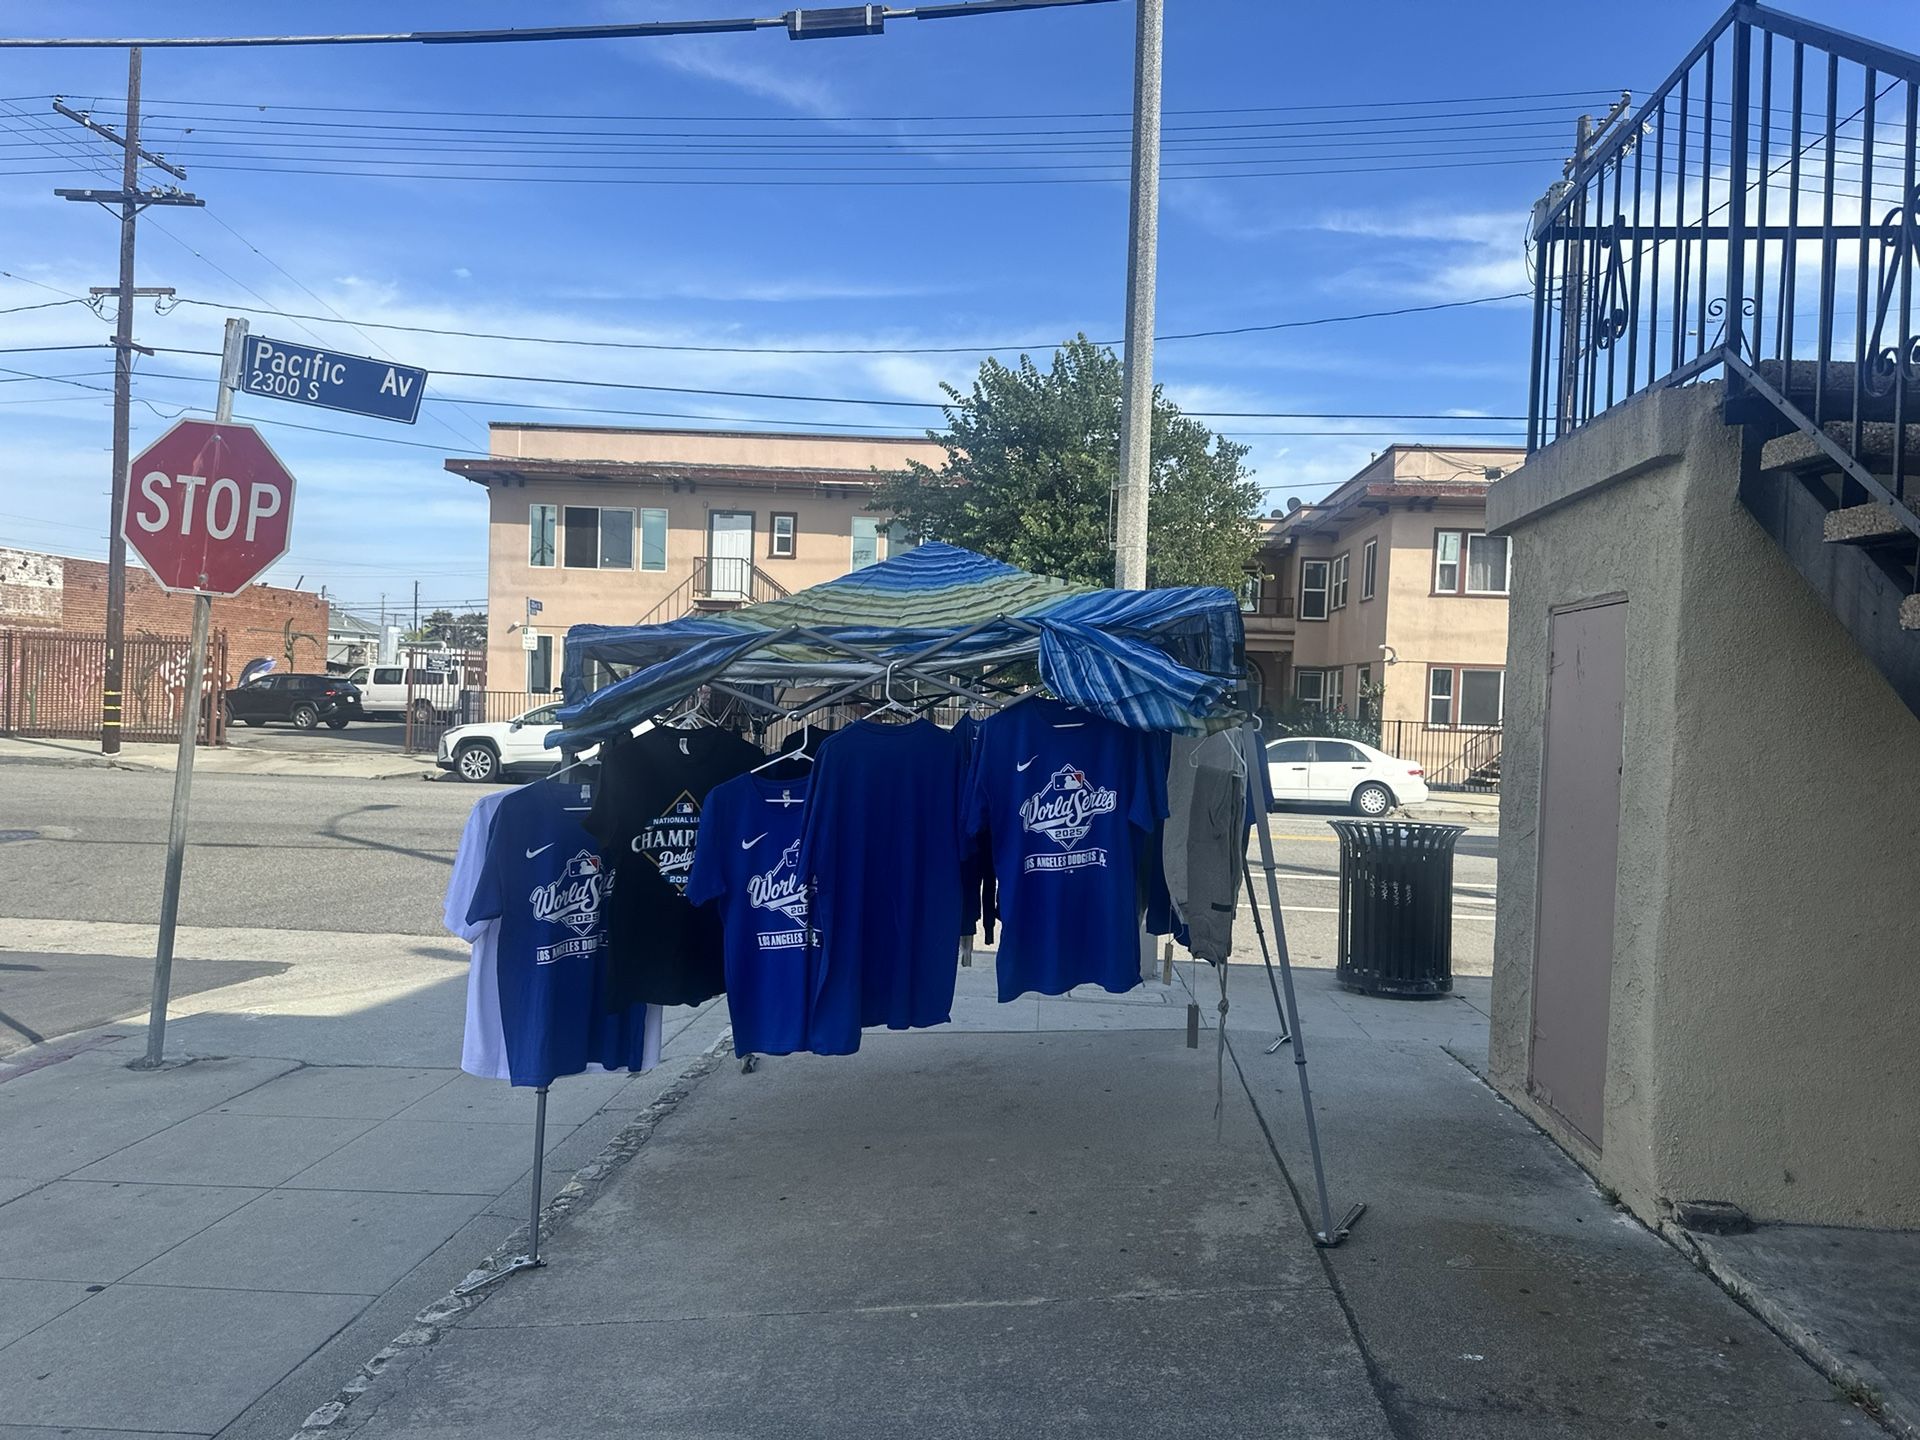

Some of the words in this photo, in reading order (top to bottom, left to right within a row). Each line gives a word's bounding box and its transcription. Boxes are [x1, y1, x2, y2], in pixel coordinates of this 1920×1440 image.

[254, 342, 346, 385] Pacific
[380, 367, 413, 398] Av
[250, 371, 300, 397] 2300
[307, 382, 320, 401] S
[136, 471, 282, 542] STOP
[1020, 792, 1075, 831] World
[1066, 787, 1116, 828] Series
[653, 816, 690, 825] NATIONAL
[1055, 828, 1083, 838] 2025
[1036, 856, 1067, 868] ANGELES
[530, 878, 591, 919] World
[758, 936, 770, 947] LOS
[771, 932, 804, 946] ANGELES
[537, 950, 550, 962] LOS
